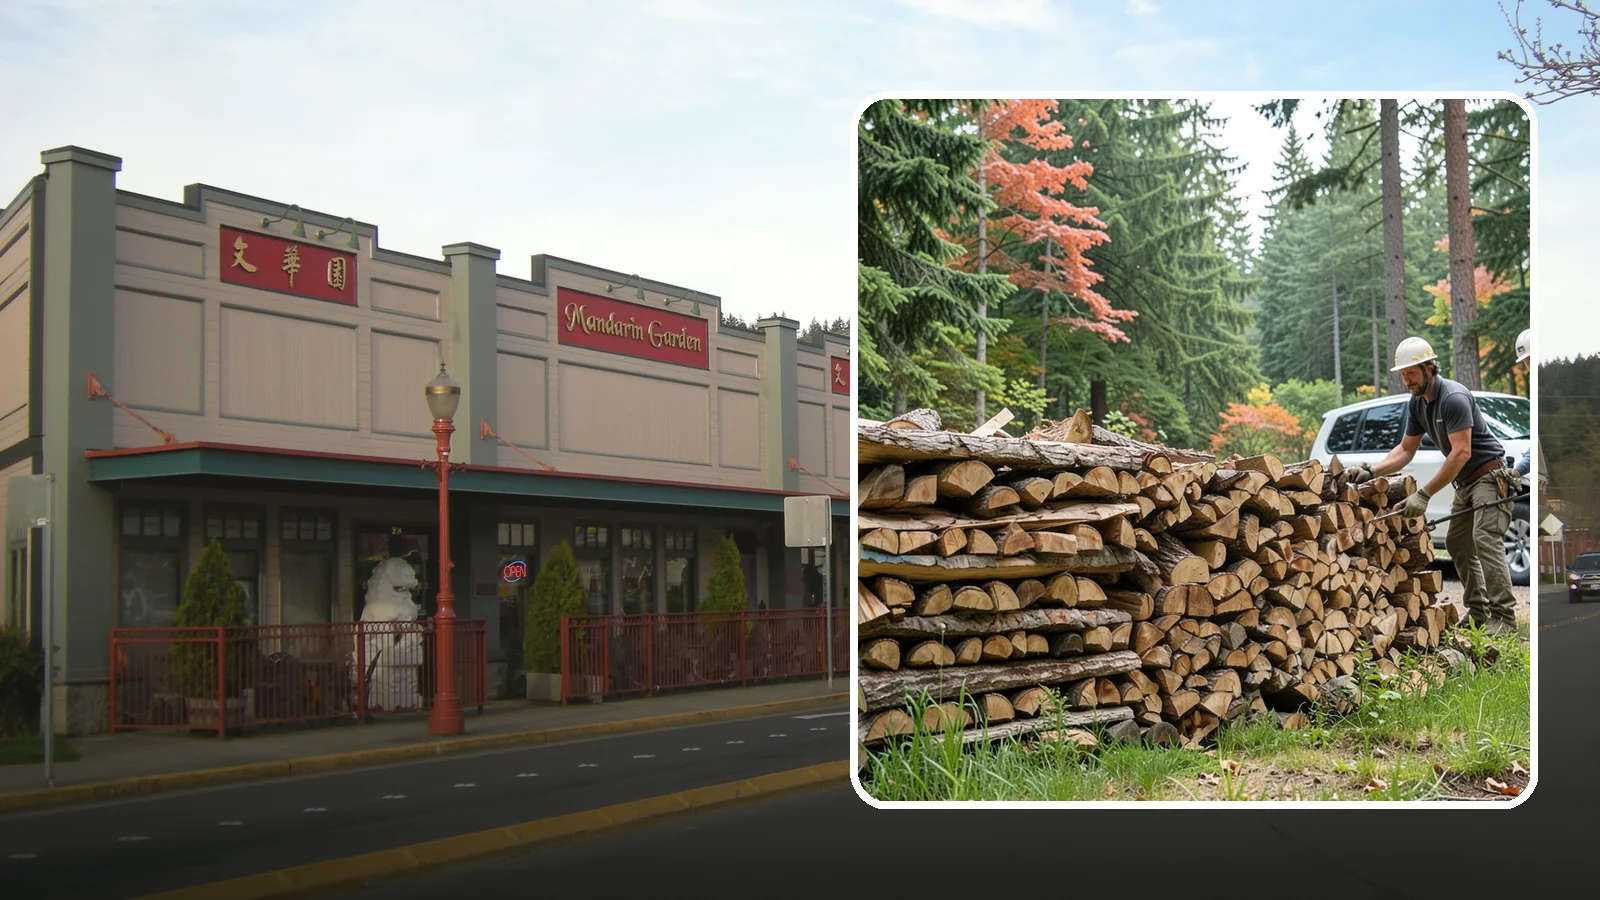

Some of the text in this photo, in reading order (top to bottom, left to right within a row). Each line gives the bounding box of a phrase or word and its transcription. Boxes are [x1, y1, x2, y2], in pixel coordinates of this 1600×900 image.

[564, 302, 702, 352] Mandarin Garden
[503, 565, 527, 578] OPEN
